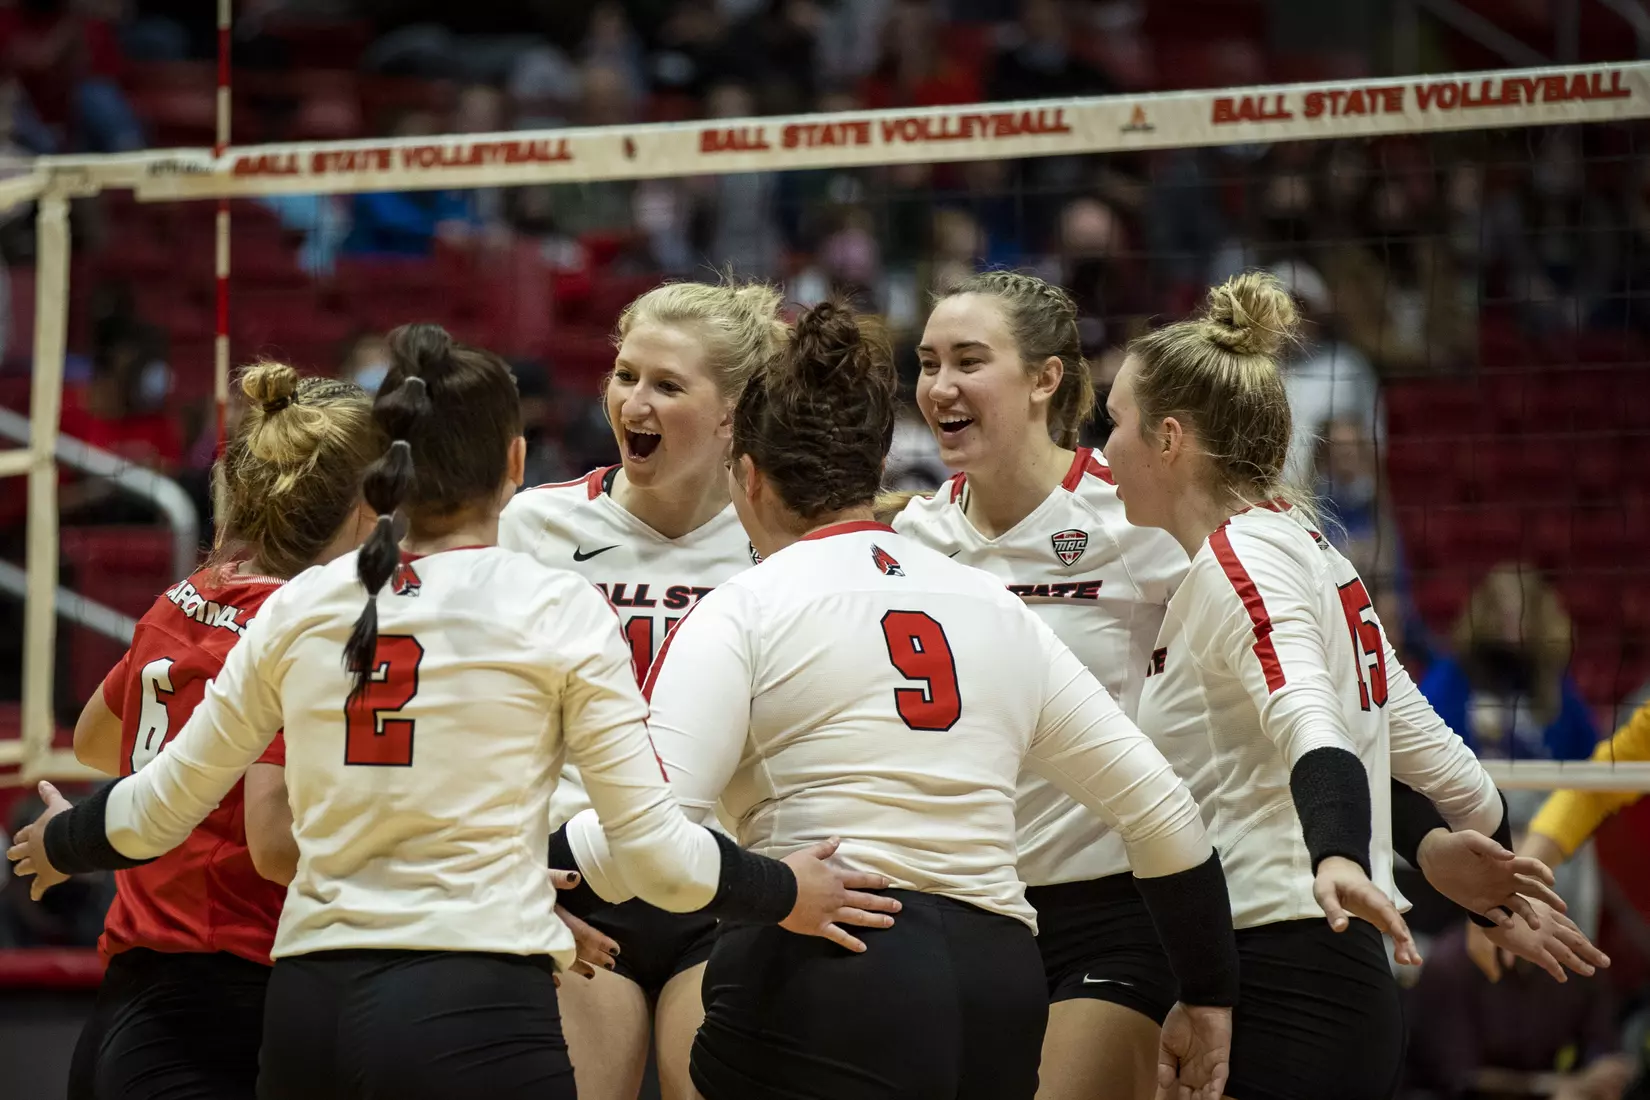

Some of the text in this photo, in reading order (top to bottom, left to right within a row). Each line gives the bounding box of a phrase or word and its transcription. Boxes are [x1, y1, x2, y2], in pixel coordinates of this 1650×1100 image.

[1211, 71, 1631, 125] BALL STATE VOLLEYBALL
[699, 107, 1071, 153] BALL STATE VOLLEYBALL
[232, 153, 299, 177] BALL
[310, 148, 390, 174] STATE
[402, 138, 572, 168] VOLLEYBALL
[1054, 540, 1086, 551] MAC
[1005, 579, 1103, 600] TATE
[880, 609, 962, 732] 9
[129, 656, 175, 774] 6
[343, 634, 425, 767] 2
